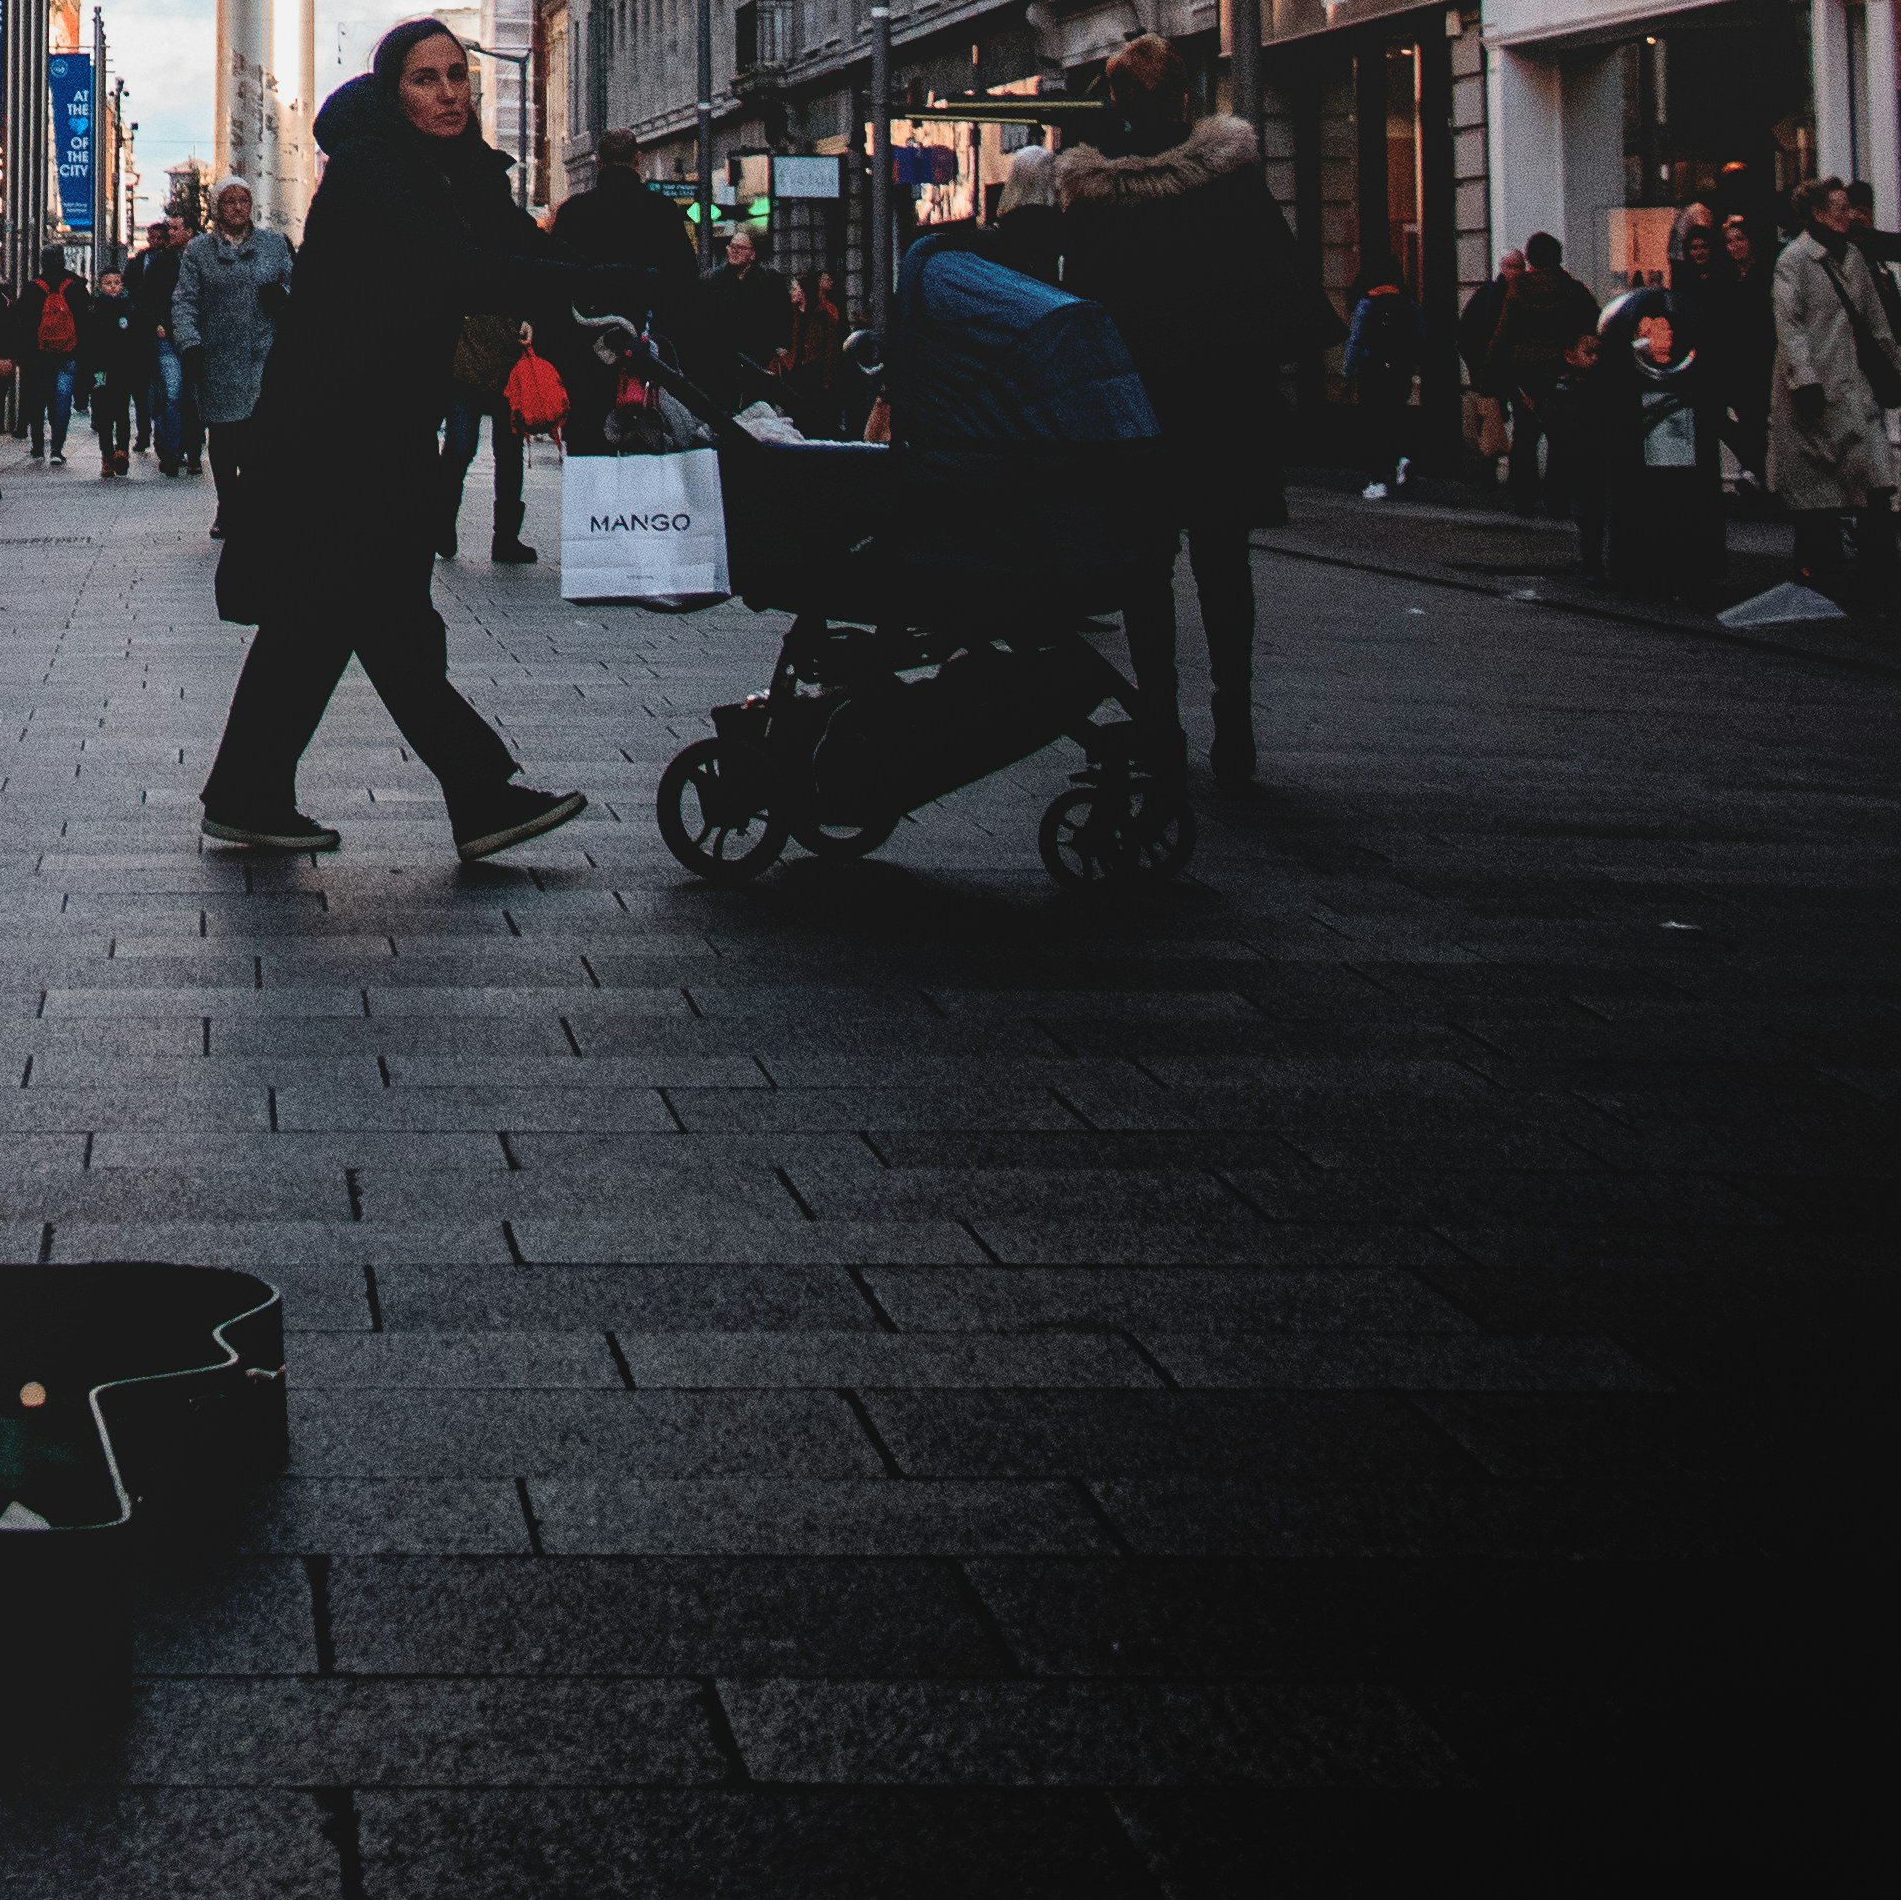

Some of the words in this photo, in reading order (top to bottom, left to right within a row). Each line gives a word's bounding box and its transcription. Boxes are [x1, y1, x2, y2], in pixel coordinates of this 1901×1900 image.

[73, 90, 89, 102] AT
[66, 103, 89, 116] THE
[70, 136, 89, 150] OF
[66, 150, 89, 163] THE
[59, 164, 89, 177] CITY
[590, 514, 691, 532] MANGO
